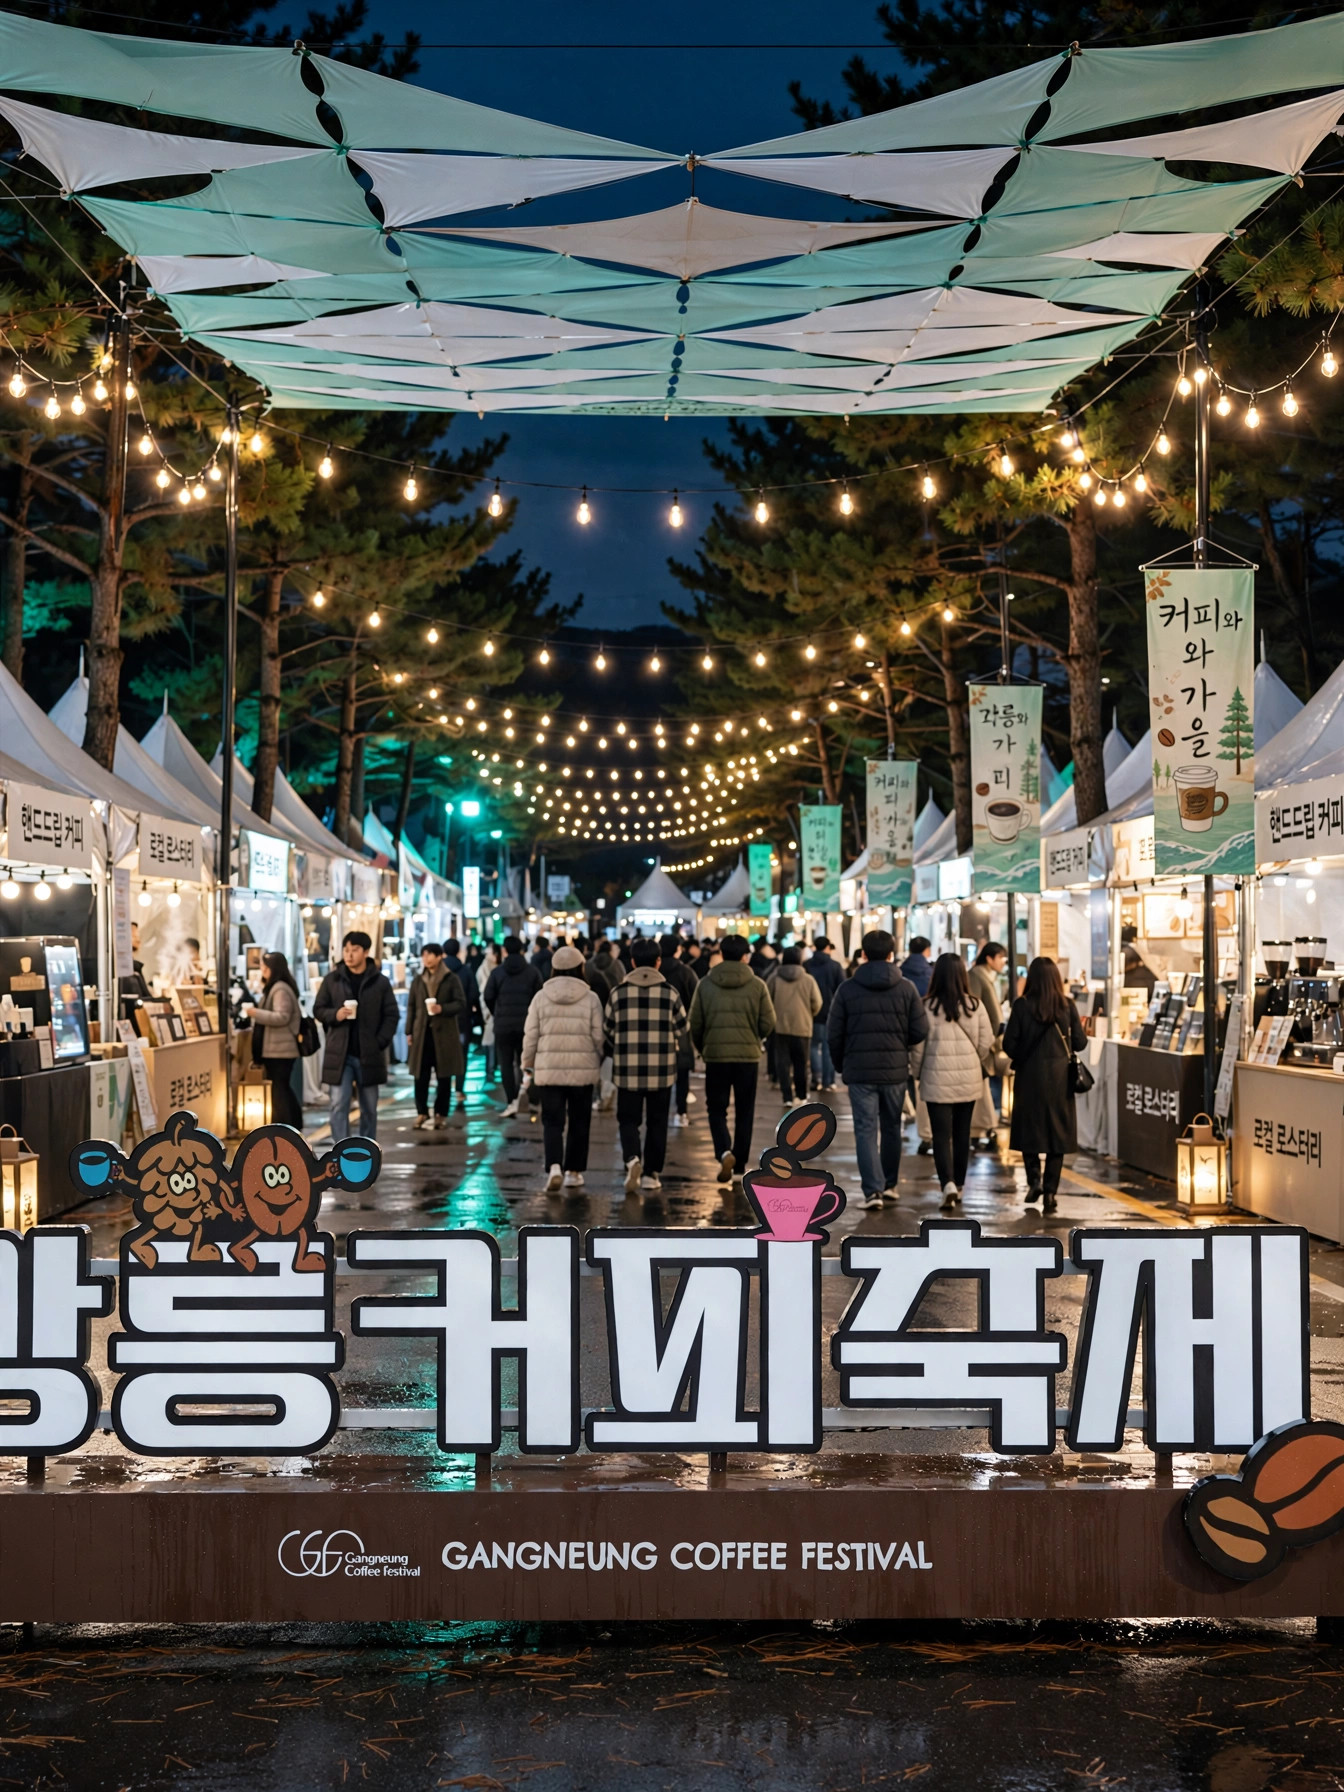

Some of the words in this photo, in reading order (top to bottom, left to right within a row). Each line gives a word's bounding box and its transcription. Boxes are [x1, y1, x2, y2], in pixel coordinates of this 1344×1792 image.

[1159, 597, 1243, 633] 커피와
[22, 803, 62, 848] 핸드드립
[65, 814, 84, 852] 커피
[1270, 801, 1315, 844] 핸드드립
[1318, 795, 1344, 836] 커피
[1126, 1083, 1142, 1115] 로컬
[1253, 1118, 1273, 1155] 로컬
[1276, 1123, 1322, 1168] 로스터리
[344, 1565, 381, 1577] Coffee
[383, 1565, 421, 1577] Festival
[345, 1552, 409, 1566] Gangneung
[441, 1541, 658, 1571] GANGNEUNG
[670, 1541, 787, 1571] COFFEE
[801, 1541, 933, 1571] FESTIVAL
